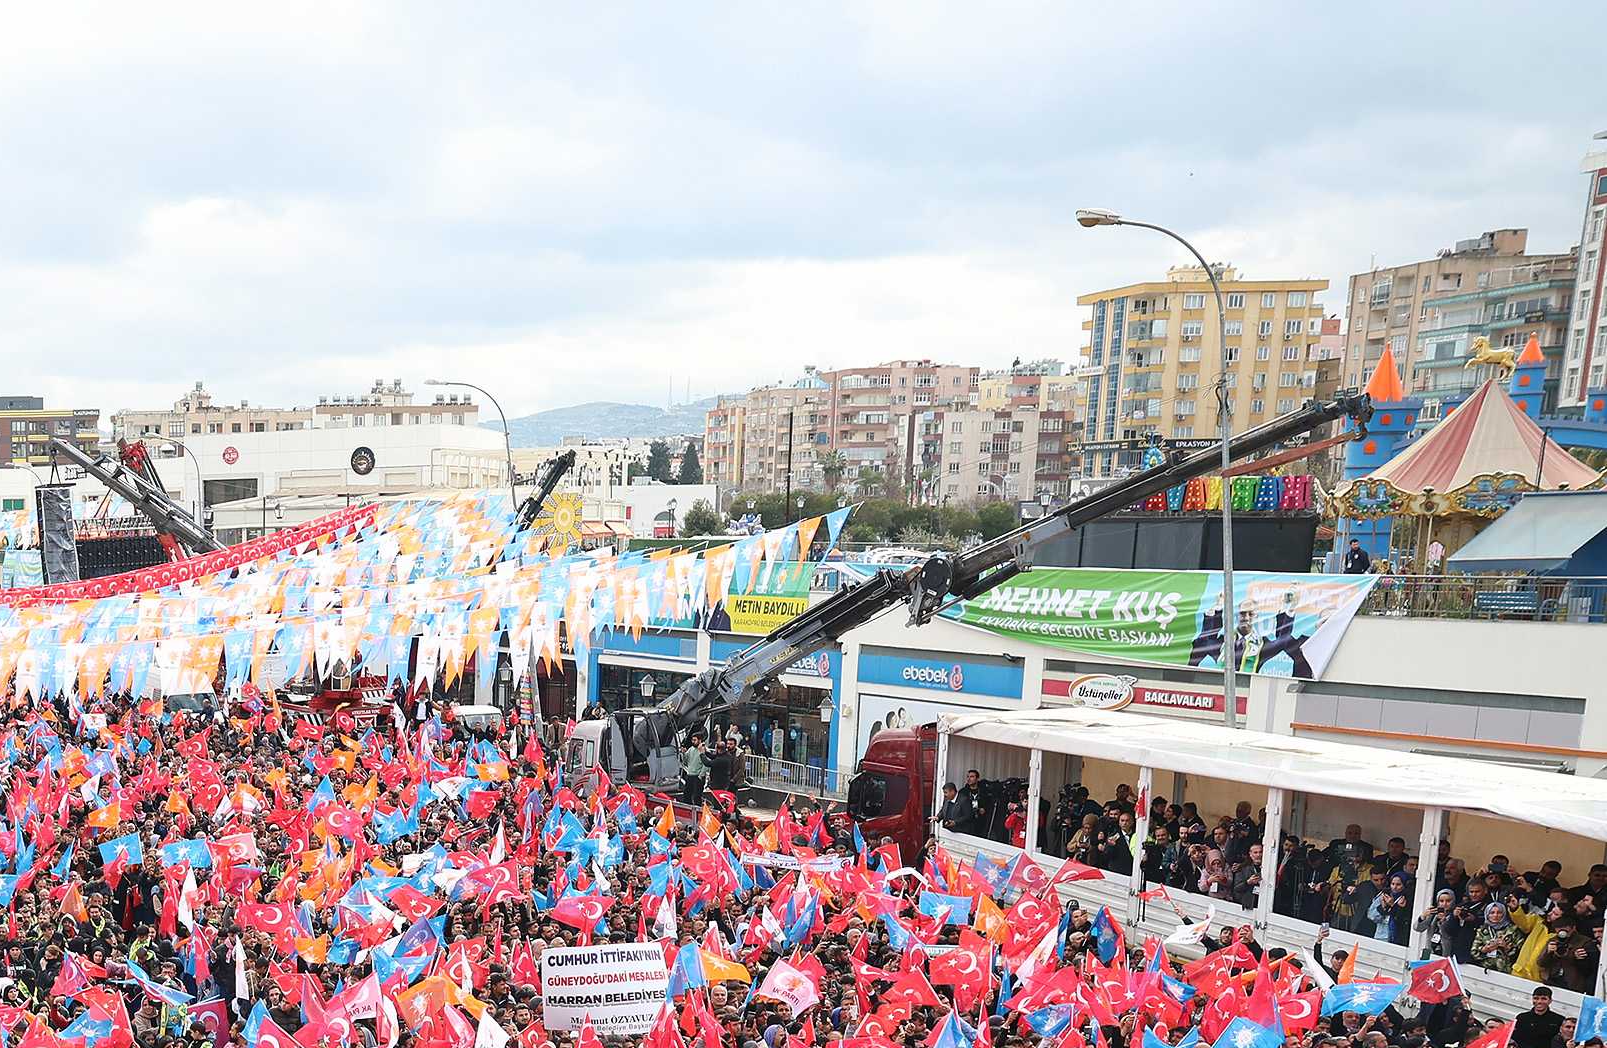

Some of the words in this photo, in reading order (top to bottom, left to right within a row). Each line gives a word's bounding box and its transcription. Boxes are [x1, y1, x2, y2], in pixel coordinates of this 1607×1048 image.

[734, 600, 762, 614] METİN
[979, 586, 1113, 619] MEHMET
[1112, 591, 1182, 631] KUŞ
[1040, 623, 1107, 641] BELEDİYE
[1109, 629, 1174, 647] BAŞKANI
[902, 665, 948, 684] ebebek
[1078, 685, 1124, 701] Üstüneller
[1144, 691, 1213, 709] BAKLAVALARI
[547, 953, 598, 967] CUMHUR
[599, 948, 662, 964] İTTİFAKI'NIN
[547, 970, 628, 987] GÜNEYDOĞU'DAKİ
[629, 970, 666, 984] MEŞALESİ
[547, 994, 602, 1006] HARRAN
[605, 988, 666, 1004] BELEDİYES
